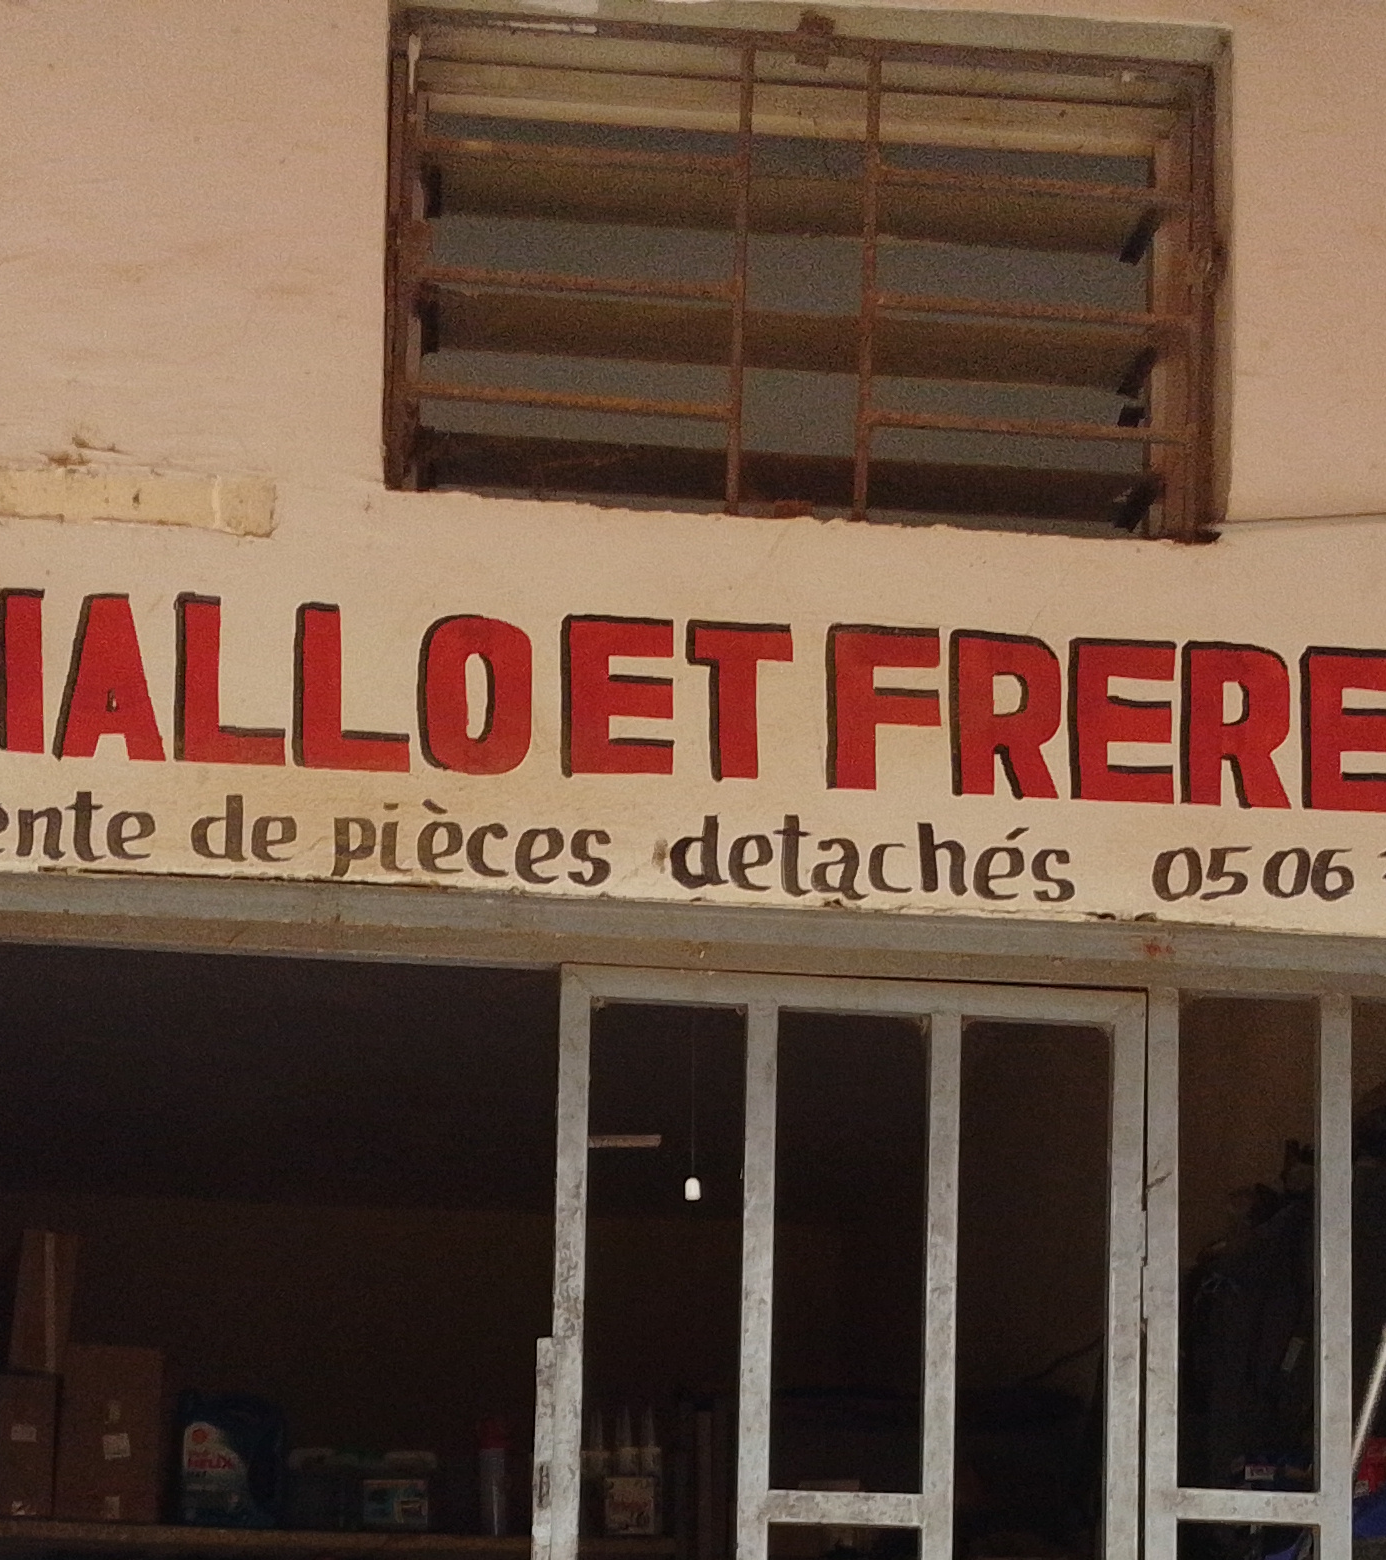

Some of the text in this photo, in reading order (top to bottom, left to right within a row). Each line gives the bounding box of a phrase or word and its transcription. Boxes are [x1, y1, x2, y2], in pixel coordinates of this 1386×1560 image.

[561, 614, 794, 781] ET
[190, 795, 298, 864] de
[332, 799, 612, 886] pièces
[670, 813, 1076, 902] detachés
